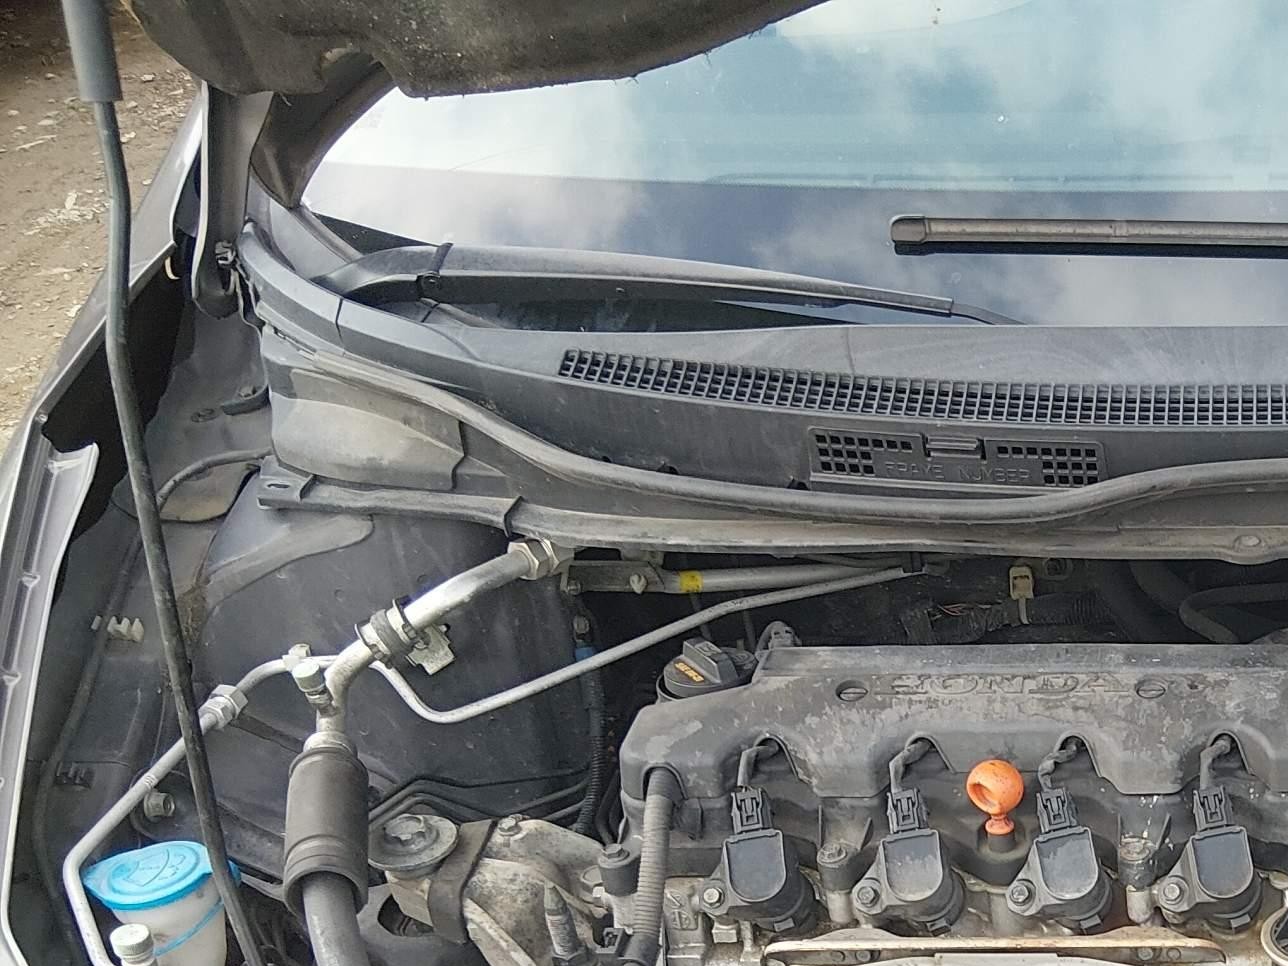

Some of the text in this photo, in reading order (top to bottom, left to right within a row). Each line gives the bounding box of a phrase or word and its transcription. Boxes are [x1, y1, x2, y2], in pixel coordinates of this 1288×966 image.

[884, 460, 1031, 483] FRAME NUMBER
[871, 672, 1131, 698] HONDA
